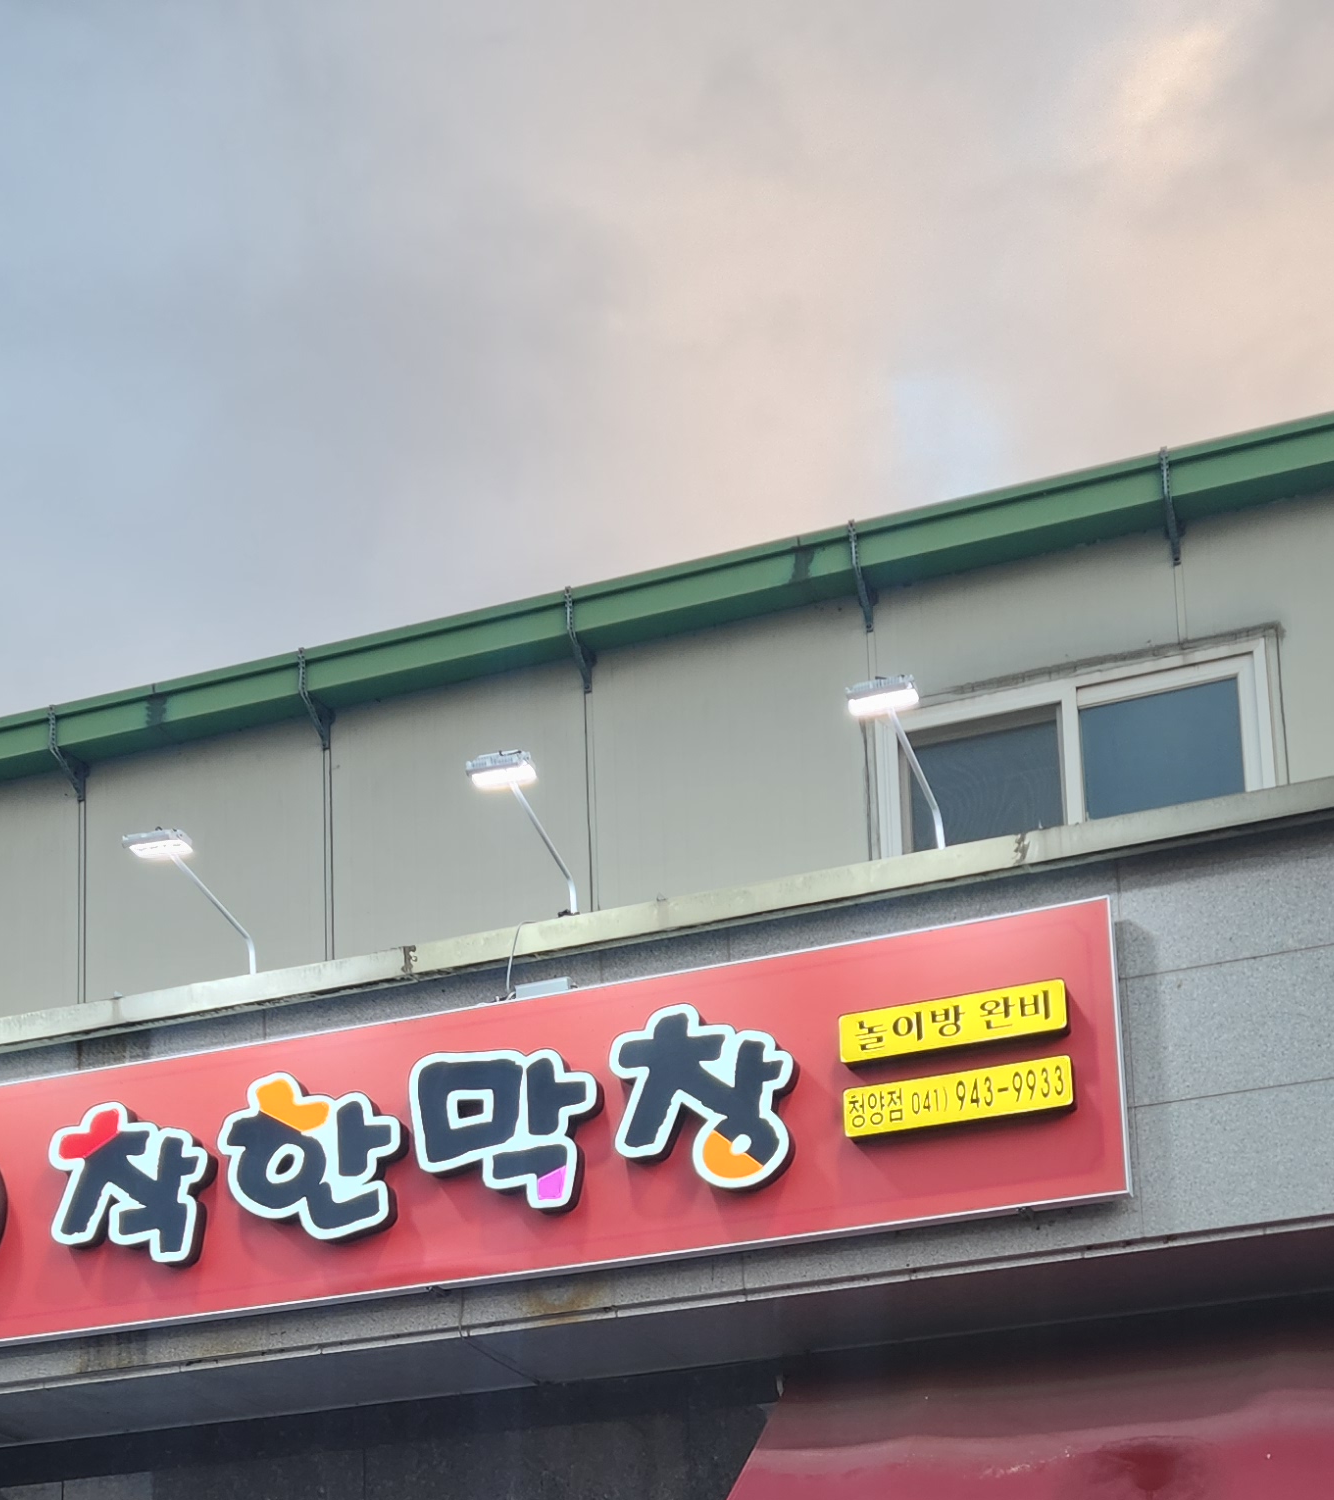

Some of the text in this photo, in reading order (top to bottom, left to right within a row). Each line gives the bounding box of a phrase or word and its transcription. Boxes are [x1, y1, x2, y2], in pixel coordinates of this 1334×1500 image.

[855, 989, 1052, 1051] 놀이방 완비
[848, 1065, 1065, 1128] 청양점 041) 943-9933
[49, 1001, 797, 1266] 착한막창
